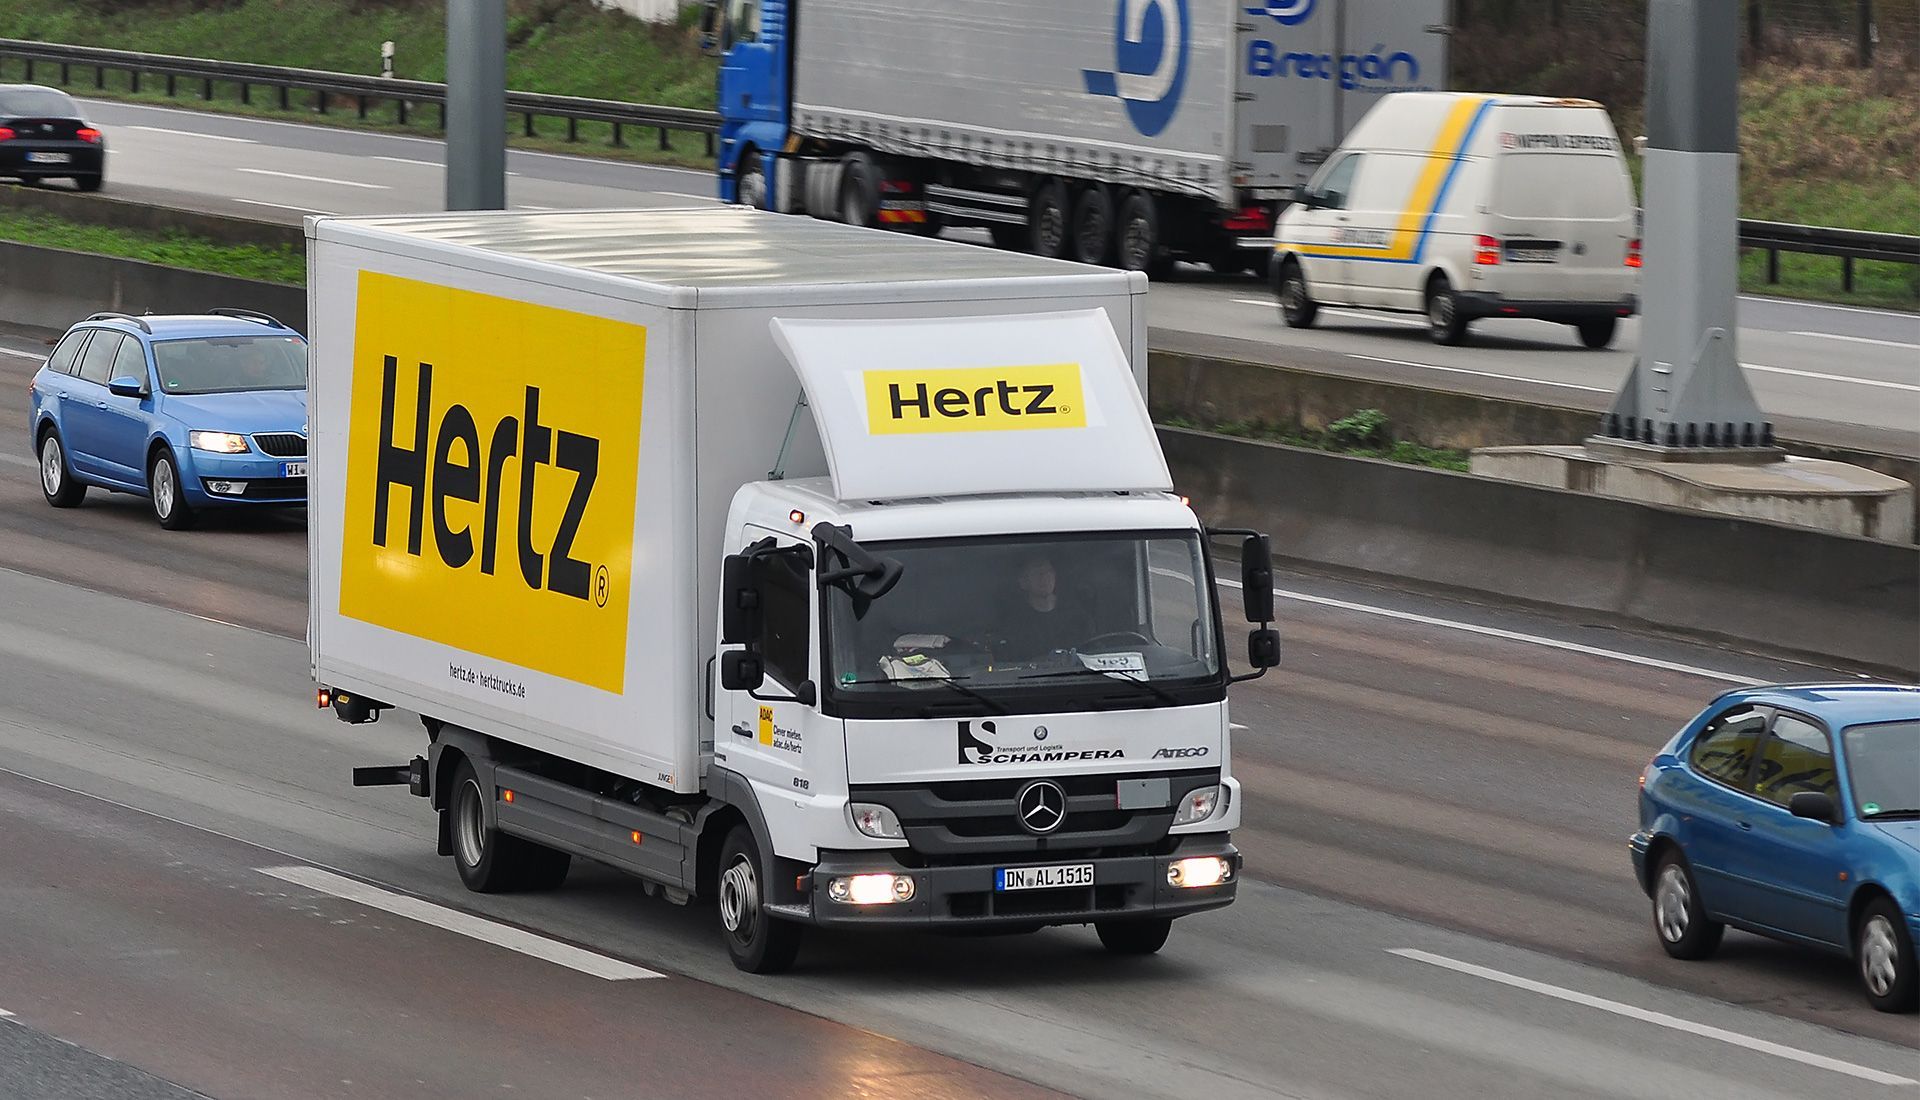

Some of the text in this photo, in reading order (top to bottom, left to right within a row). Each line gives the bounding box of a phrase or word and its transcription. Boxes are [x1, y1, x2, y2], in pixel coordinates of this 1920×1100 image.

[888, 380, 1057, 419] Hertz
[372, 354, 599, 601] Hertz
[977, 749, 1125, 764] SCHAMPERA
[997, 745, 1026, 753] Transport
[1039, 744, 1063, 752] Logistik
[1006, 871, 1025, 888] DN
[1056, 866, 1093, 885] 1515
